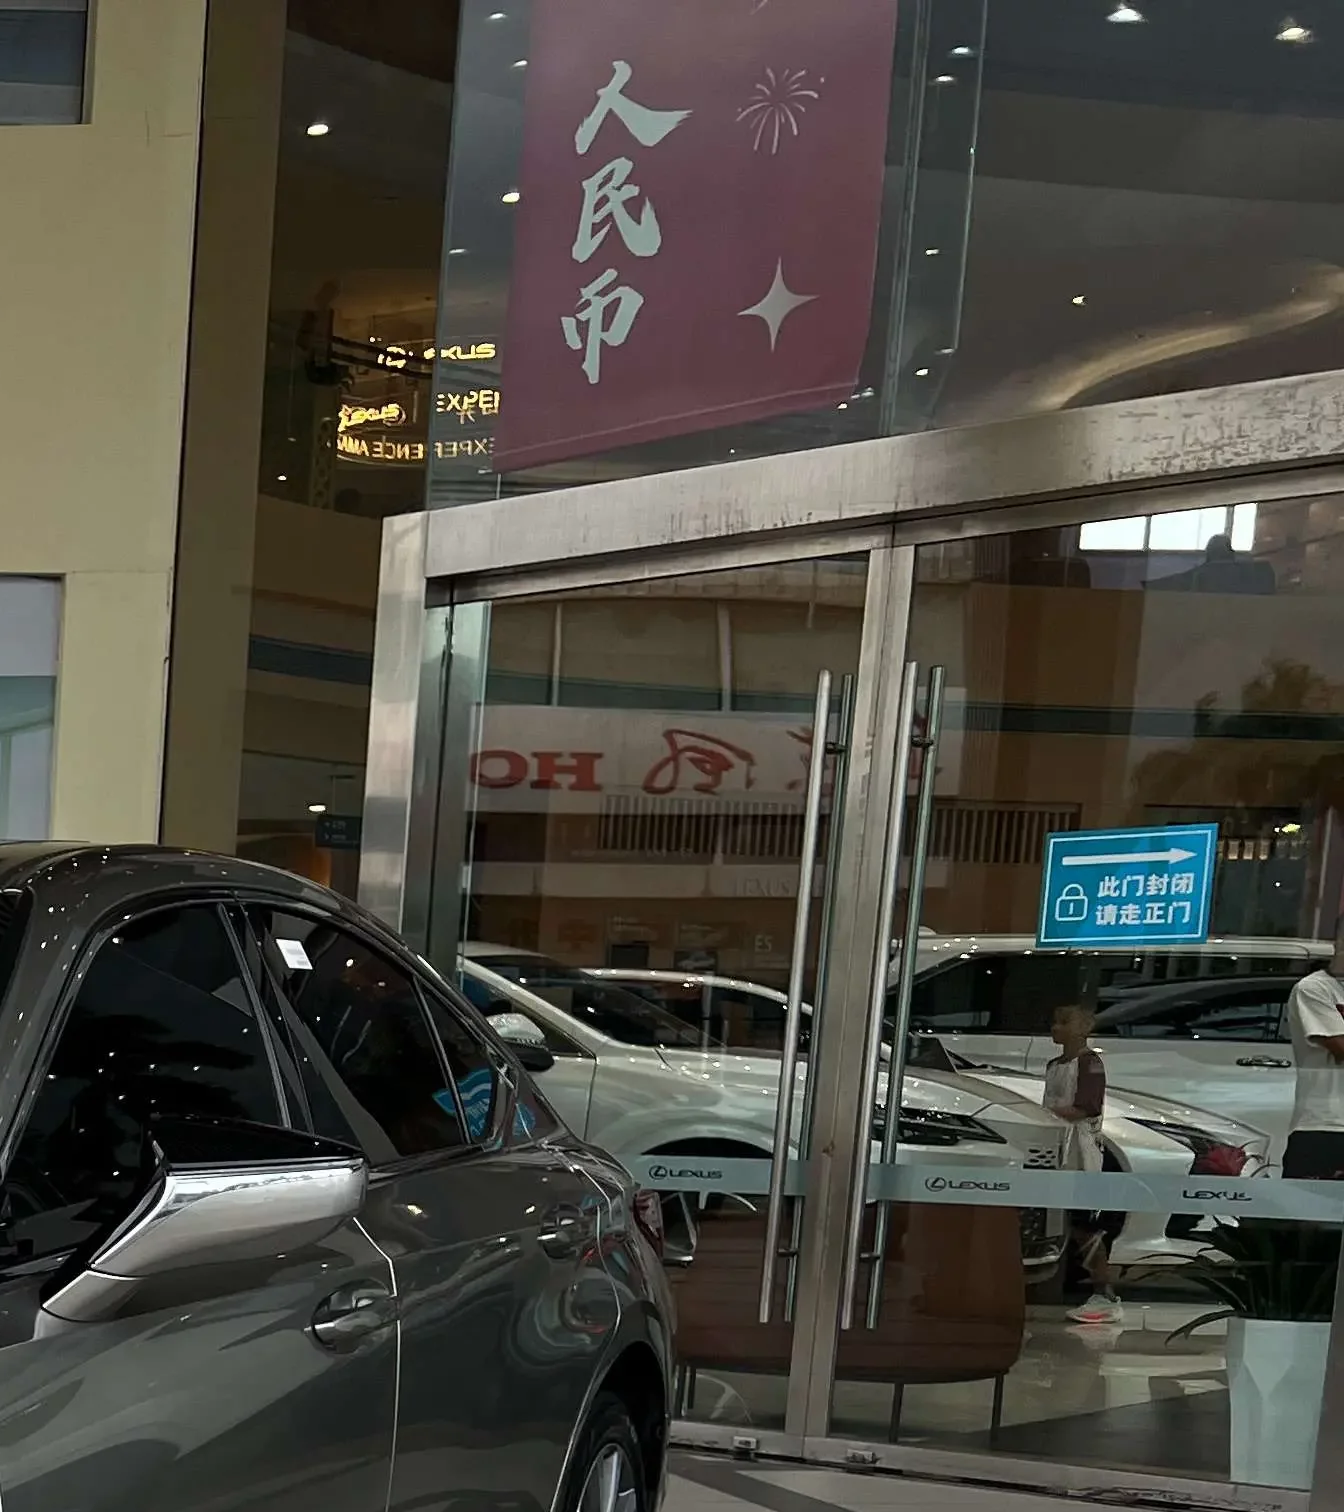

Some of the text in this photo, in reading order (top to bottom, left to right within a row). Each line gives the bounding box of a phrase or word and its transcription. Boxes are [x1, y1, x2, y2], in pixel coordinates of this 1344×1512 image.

[560, 59, 694, 385] 人民币
[1096, 872, 1195, 898] 此门封闭
[1095, 901, 1192, 926] 请走正门
[668, 1168, 723, 1180] LEXUS
[947, 1180, 1011, 1192] LEXUS
